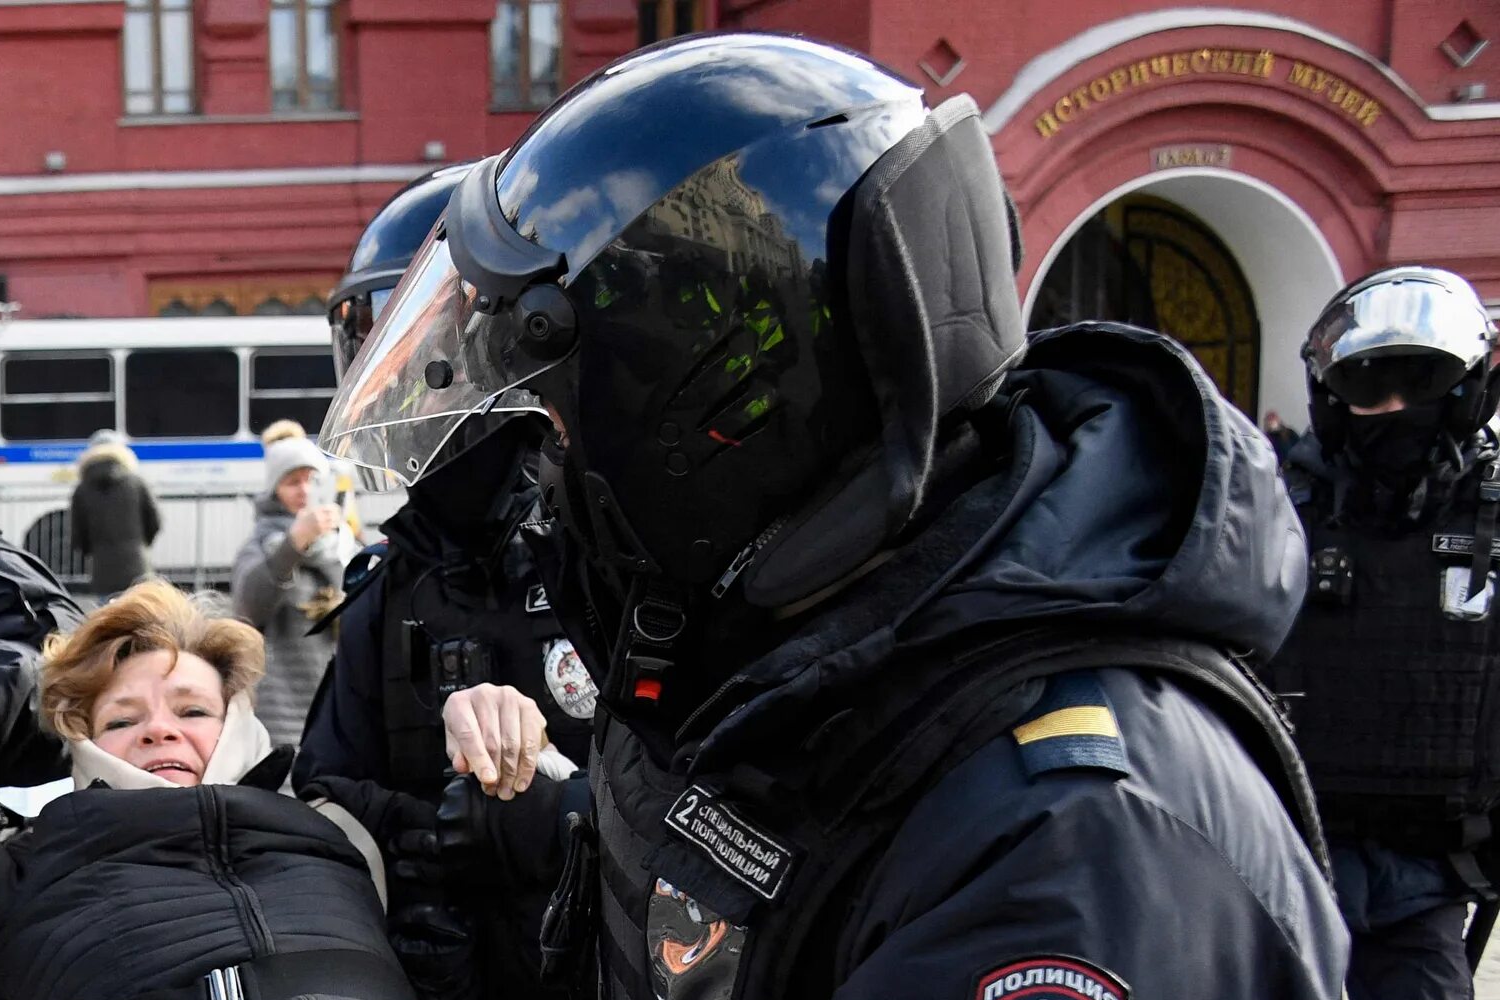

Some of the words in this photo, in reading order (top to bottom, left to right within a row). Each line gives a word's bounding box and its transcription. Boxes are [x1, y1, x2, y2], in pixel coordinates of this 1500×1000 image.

[1034, 49, 1276, 138] ИСТОРИЧЕСКИЙ
[1286, 60, 1382, 128] МУЗЕЙ
[1438, 537, 1449, 550] 2
[533, 586, 549, 607] 2
[675, 794, 699, 826] 2
[698, 805, 781, 870] СПЕЦИАЛЬНЫЙ
[714, 837, 771, 885] ПОЛИЦИИ
